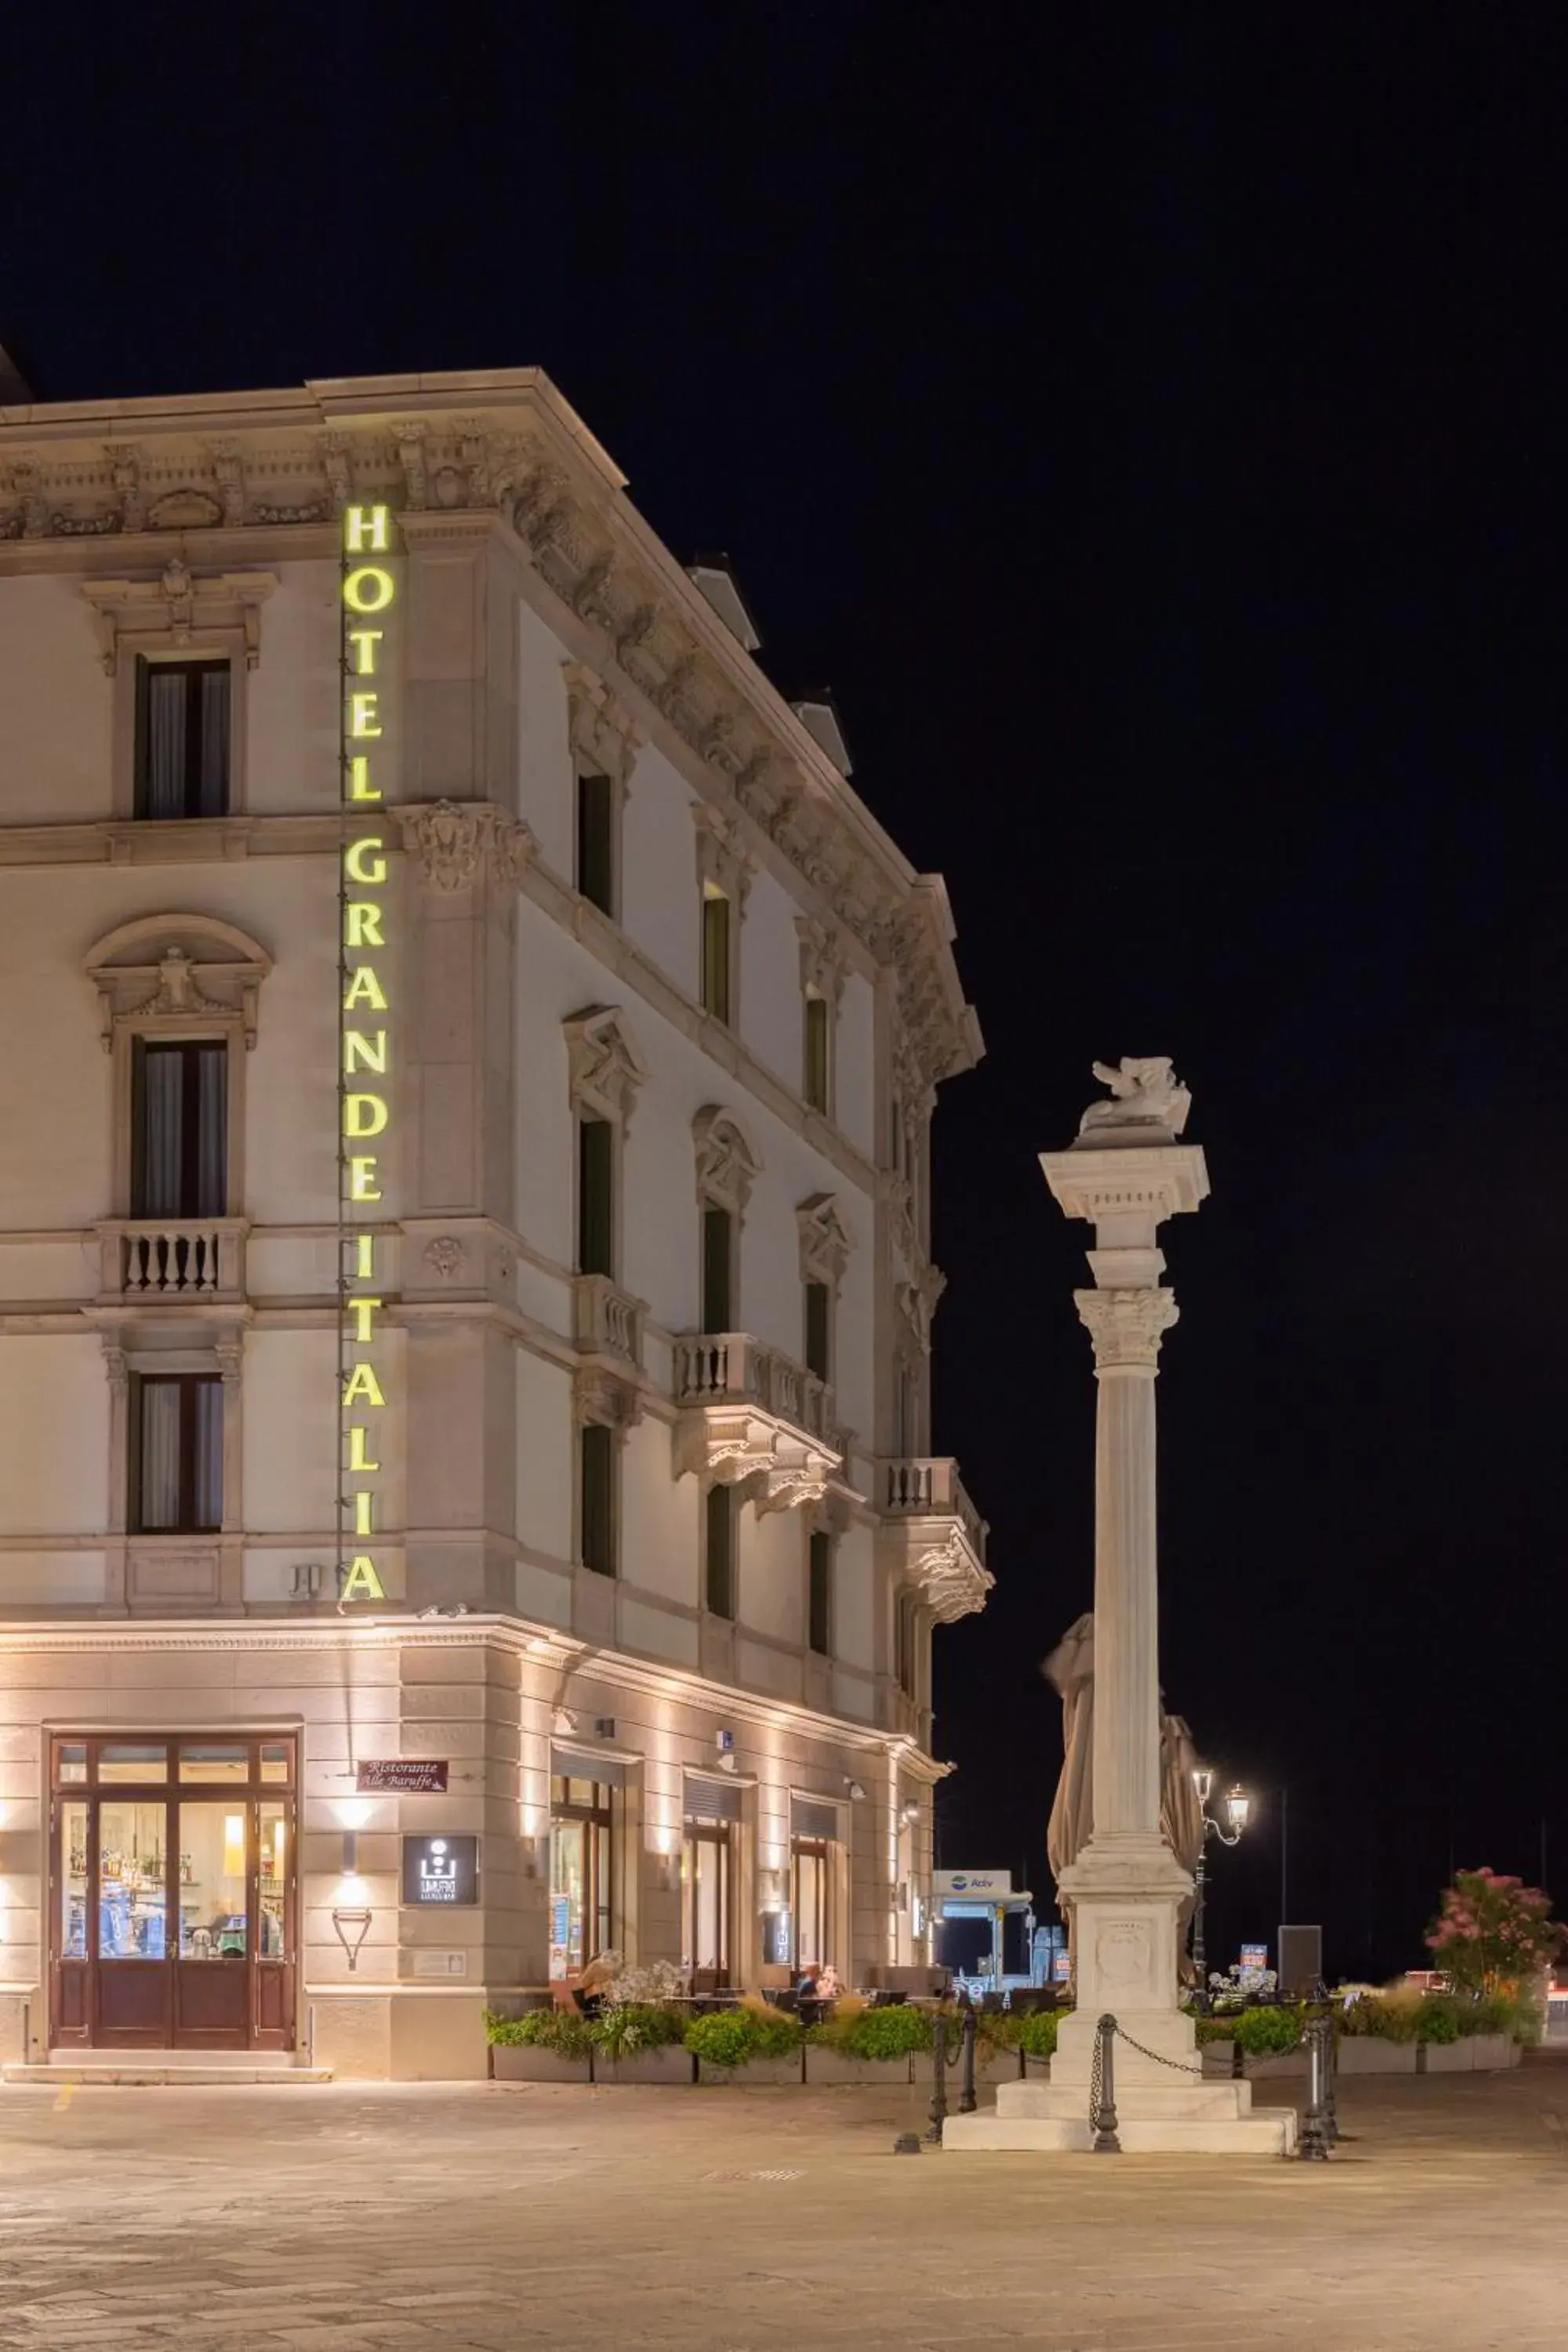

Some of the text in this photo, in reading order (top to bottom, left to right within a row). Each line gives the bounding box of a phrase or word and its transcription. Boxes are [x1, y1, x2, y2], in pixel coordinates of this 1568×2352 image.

[343, 506, 394, 1602] HOTEL GRANDE ITALIA
[368, 1762, 437, 1773] Ristorante
